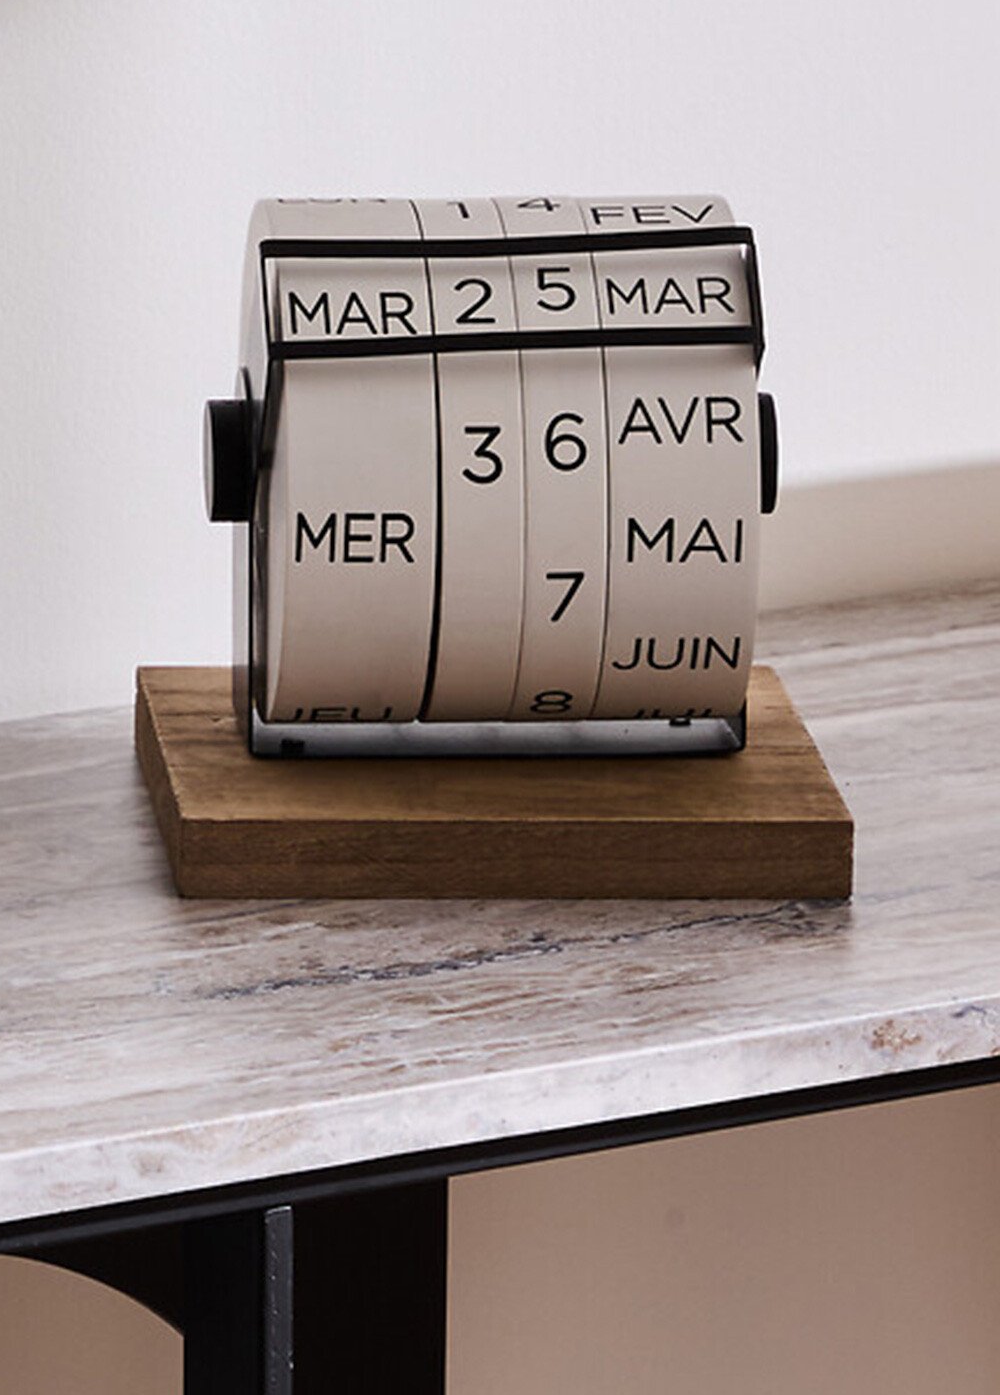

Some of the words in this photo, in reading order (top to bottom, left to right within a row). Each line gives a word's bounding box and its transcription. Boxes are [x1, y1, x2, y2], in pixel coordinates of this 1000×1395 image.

[447, 201, 470, 220] 1
[517, 197, 561, 212] 4
[590, 204, 714, 225] FEV
[288, 291, 418, 335] MAR
[453, 279, 497, 325] 2
[537, 267, 577, 312] 5
[605, 277, 735, 316] MAR
[462, 426, 504, 485] 3
[544, 412, 588, 472] 6
[618, 397, 744, 445] AVR
[294, 512, 416, 564] MER
[626, 517, 744, 564] MAI
[546, 571, 585, 622] 7
[611, 637, 742, 670] JUIN
[530, 691, 574, 715] 8
